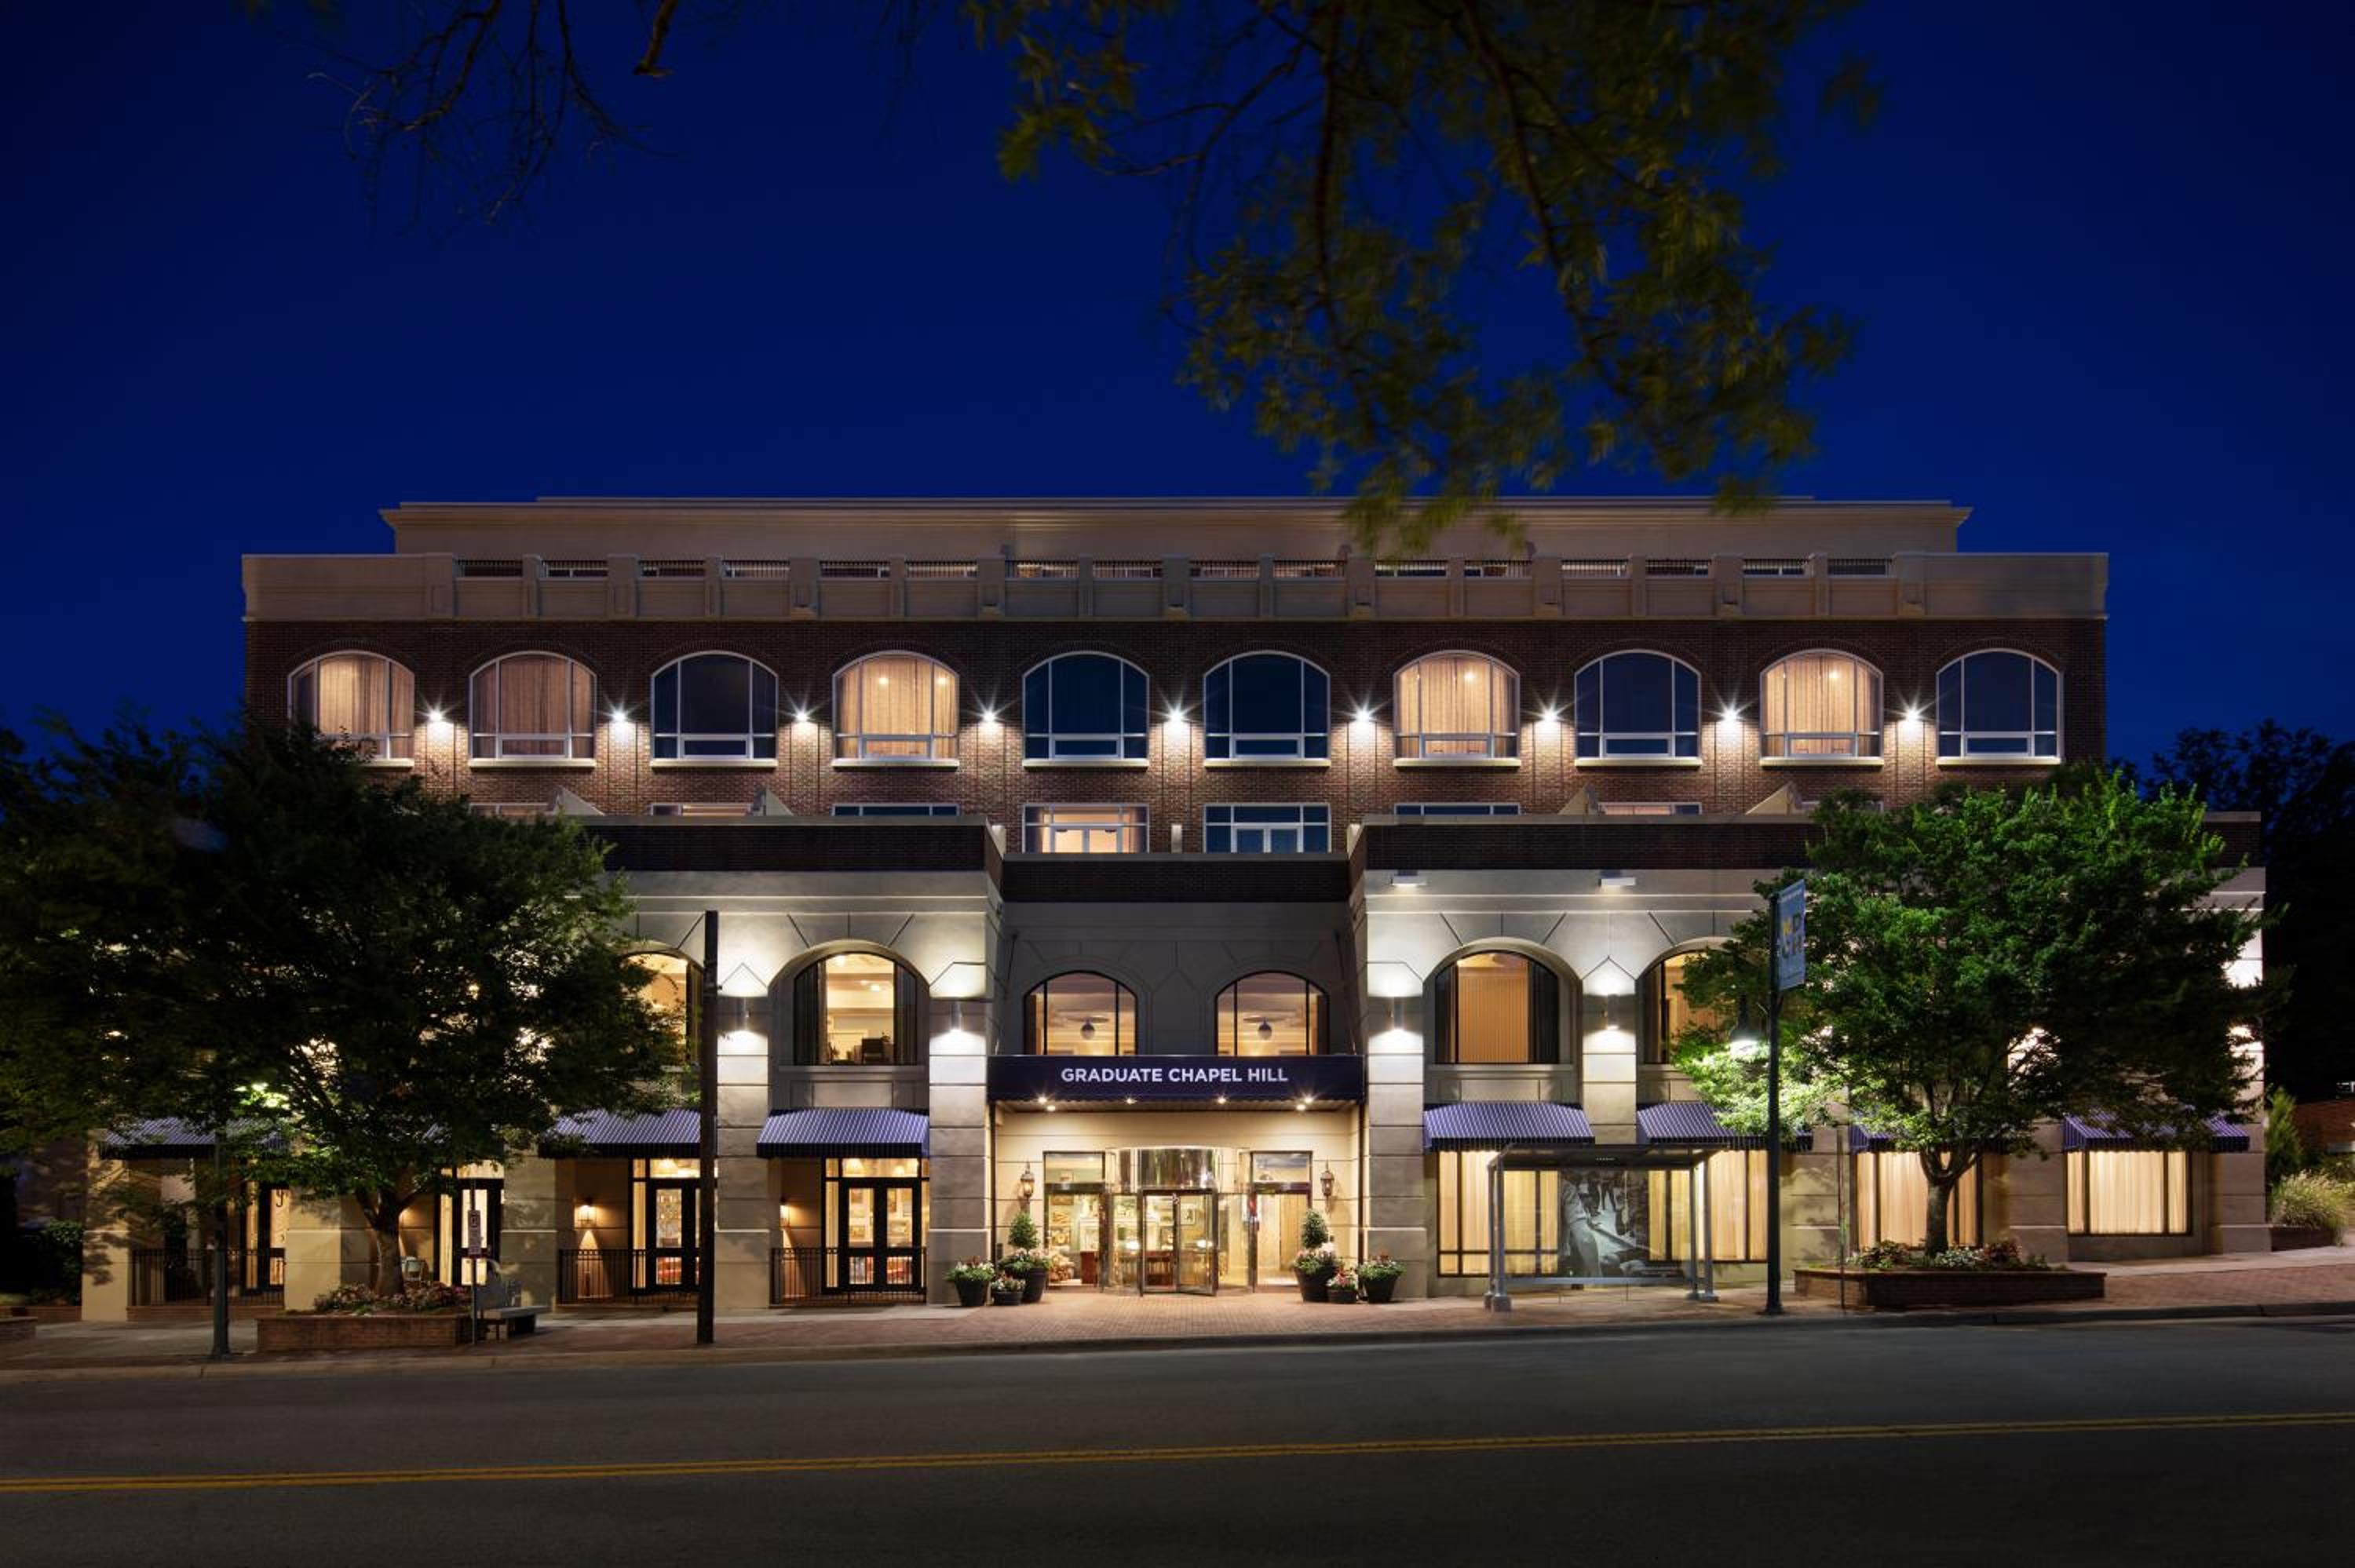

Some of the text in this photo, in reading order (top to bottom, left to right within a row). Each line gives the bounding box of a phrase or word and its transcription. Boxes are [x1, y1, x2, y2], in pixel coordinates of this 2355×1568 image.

[1061, 1067, 1289, 1082] GRADUATE CHAPEL HILL
